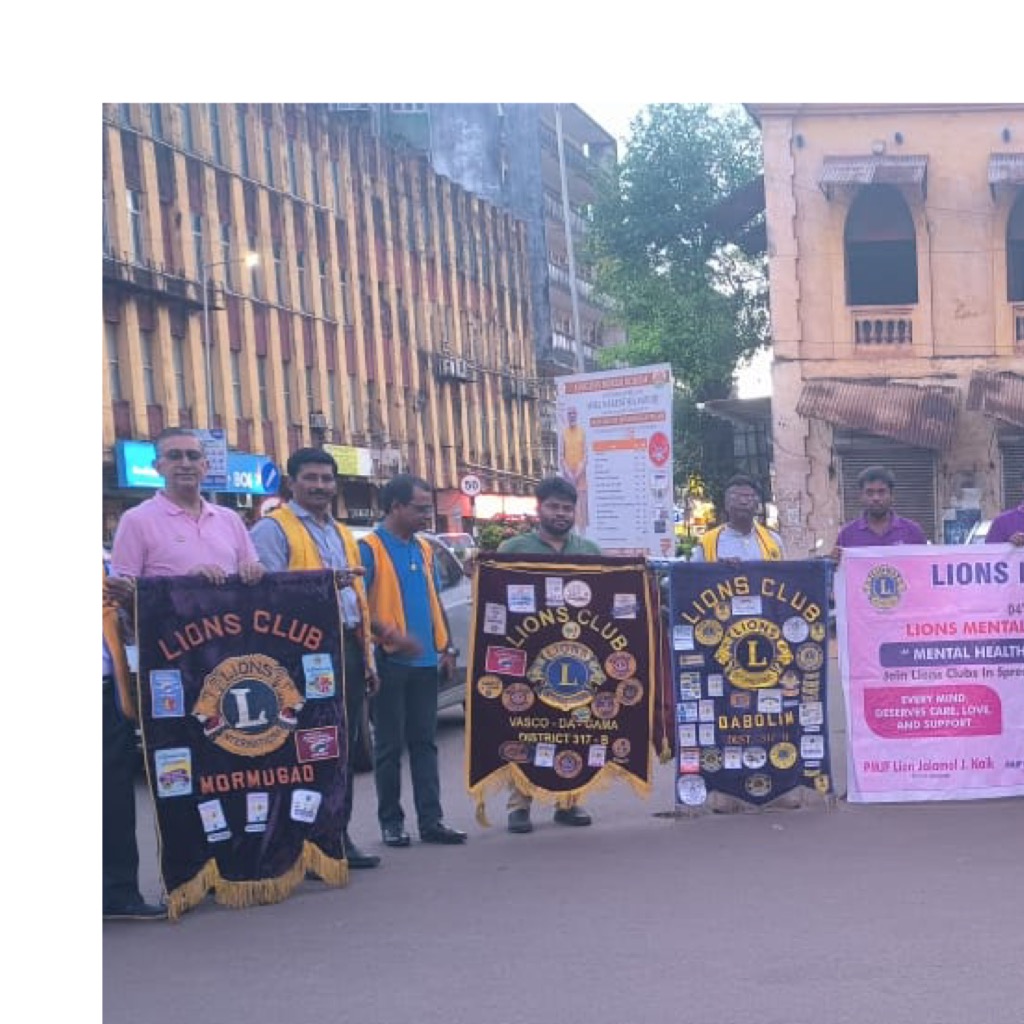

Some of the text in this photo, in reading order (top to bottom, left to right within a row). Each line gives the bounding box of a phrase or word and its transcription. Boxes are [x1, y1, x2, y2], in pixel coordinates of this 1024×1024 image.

[932, 561, 1008, 586] LIONS
[681, 576, 821, 624] LIONS CLUB
[157, 609, 324, 661] LIONS CLUB
[506, 606, 628, 650] LIONS CLUB
[731, 619, 779, 639] LIONS
[906, 622, 958, 637] LIONS
[747, 640, 768, 667] L
[913, 646, 970, 660] MENTAL
[559, 662, 579, 686] L
[911, 667, 943, 681] Lions
[946, 666, 978, 679] Clubs
[982, 665, 994, 677] In
[229, 688, 269, 729] L
[875, 707, 926, 718] DESERVES
[509, 716, 549, 728] VASCO
[585, 719, 618, 731] GAMA
[897, 718, 972, 730] AND SUPPORT
[518, 733, 567, 744] DISTRICT
[200, 764, 315, 795] MORMUGAO
